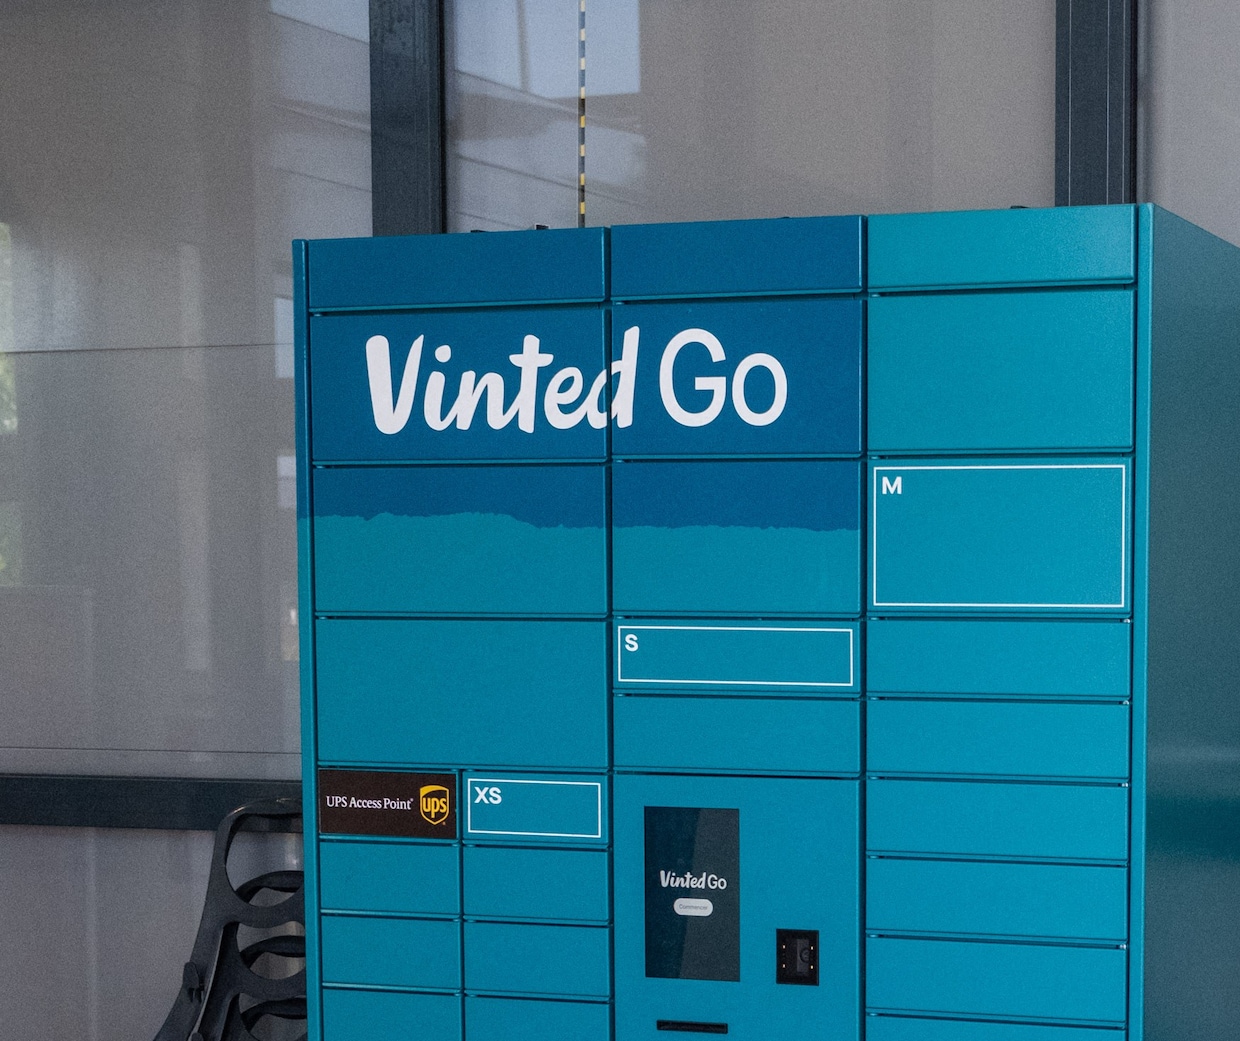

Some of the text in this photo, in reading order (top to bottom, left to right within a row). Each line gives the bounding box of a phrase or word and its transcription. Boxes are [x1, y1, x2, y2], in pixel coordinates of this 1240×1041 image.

[365, 326, 788, 434] Vinted Go
[881, 476, 903, 495] M
[624, 633, 639, 652] S
[326, 795, 347, 807] UPS
[349, 797, 382, 809] Access
[474, 786, 502, 804] XS
[422, 797, 448, 818] ups
[660, 870, 727, 889] Vinted Go
